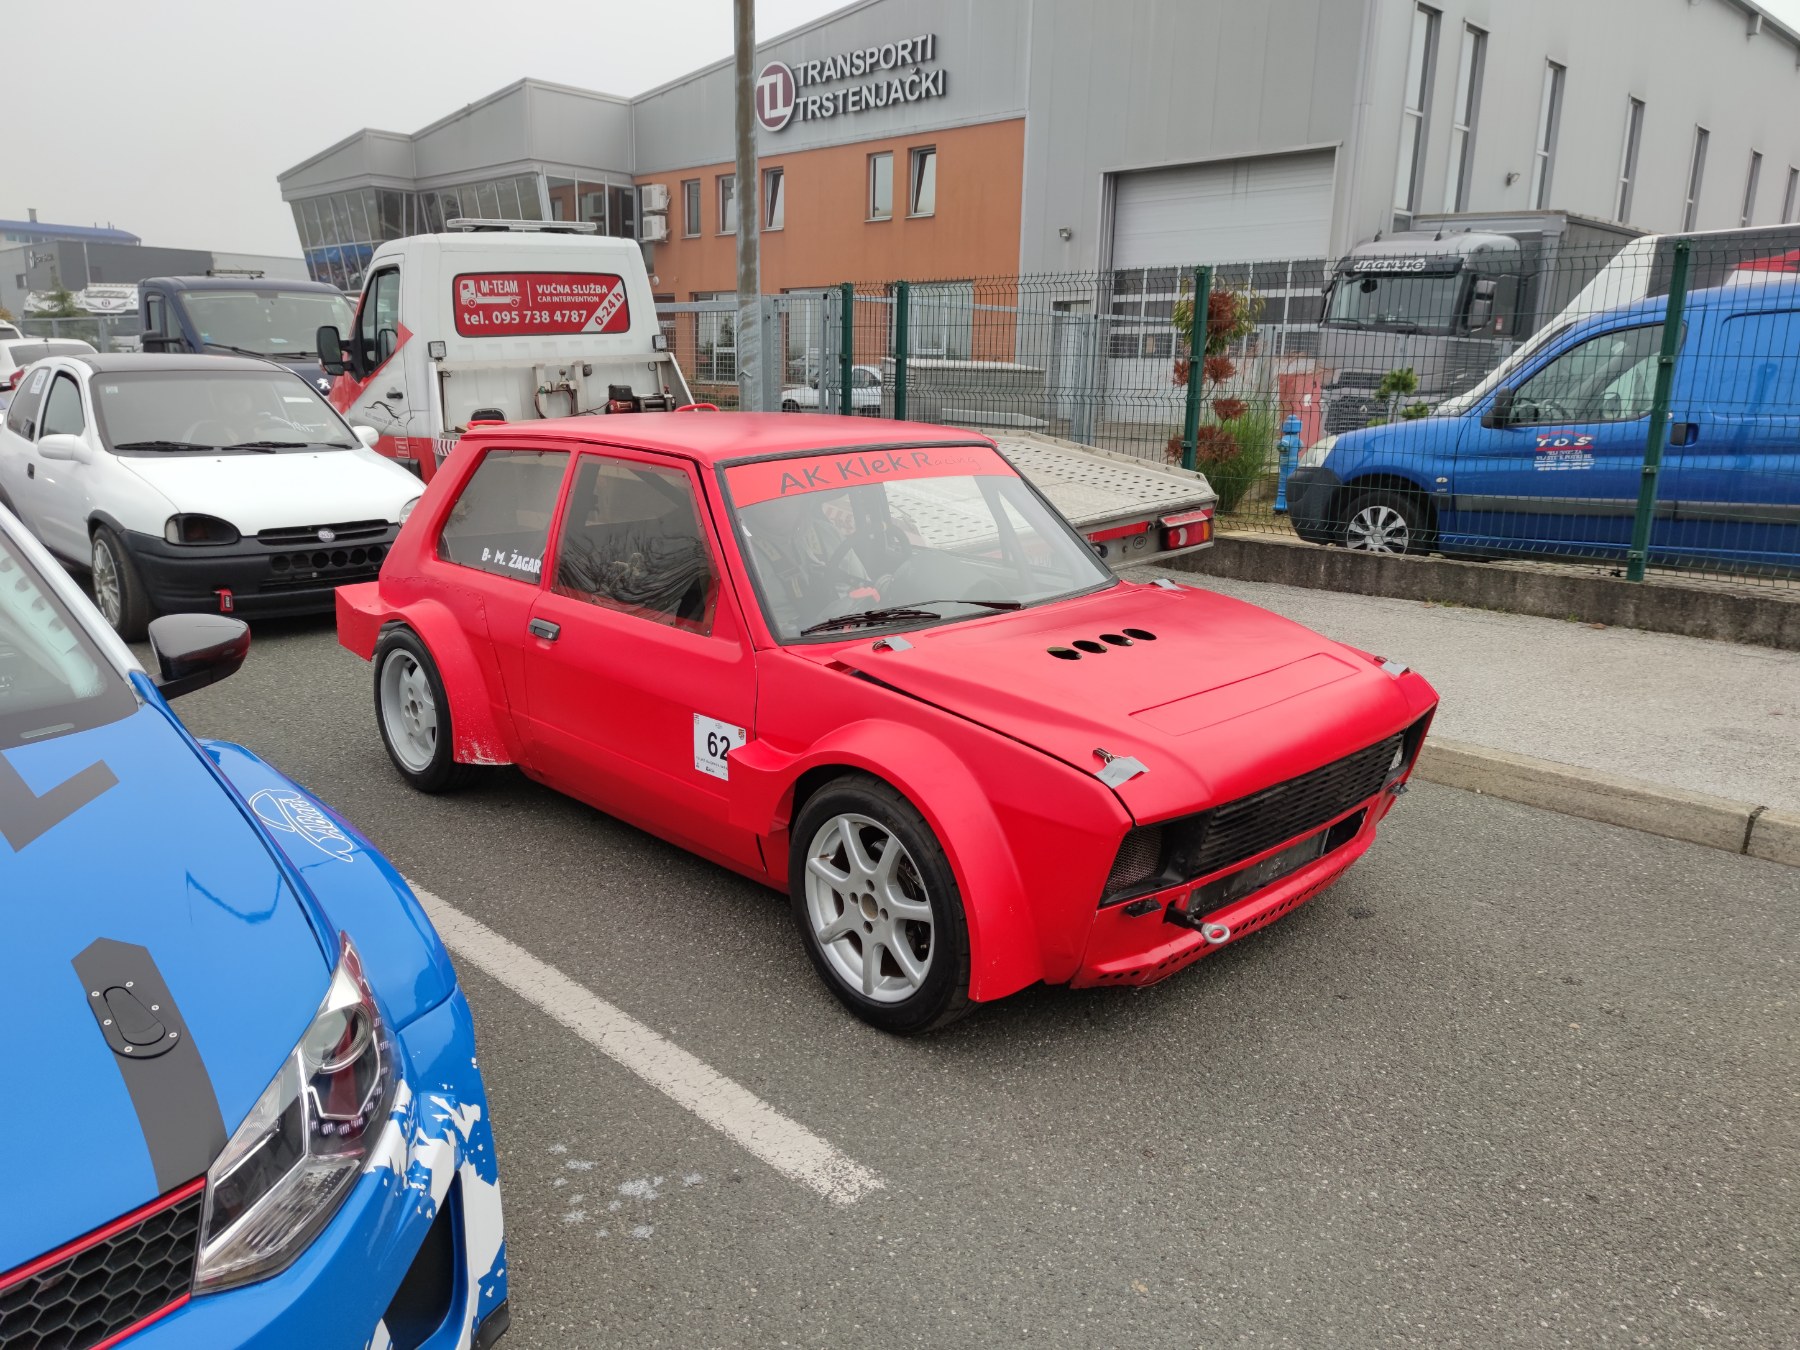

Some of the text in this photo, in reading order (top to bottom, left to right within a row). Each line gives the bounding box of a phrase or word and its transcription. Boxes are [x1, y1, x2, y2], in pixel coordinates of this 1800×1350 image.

[796, 33, 935, 87] TRANSPORTI
[795, 68, 945, 121] TRSTENJAČKI
[480, 280, 519, 294] M-TEAM
[536, 283, 608, 294] VUČNA SLUŽBA
[464, 310, 588, 325] tel. 095 738 4787
[594, 291, 624, 327] 0-24 h
[780, 465, 831, 494] AK
[835, 452, 909, 480] Klek
[494, 549, 506, 566] M.
[508, 549, 542, 574] ŽAGAR
[707, 731, 731, 762] 62
